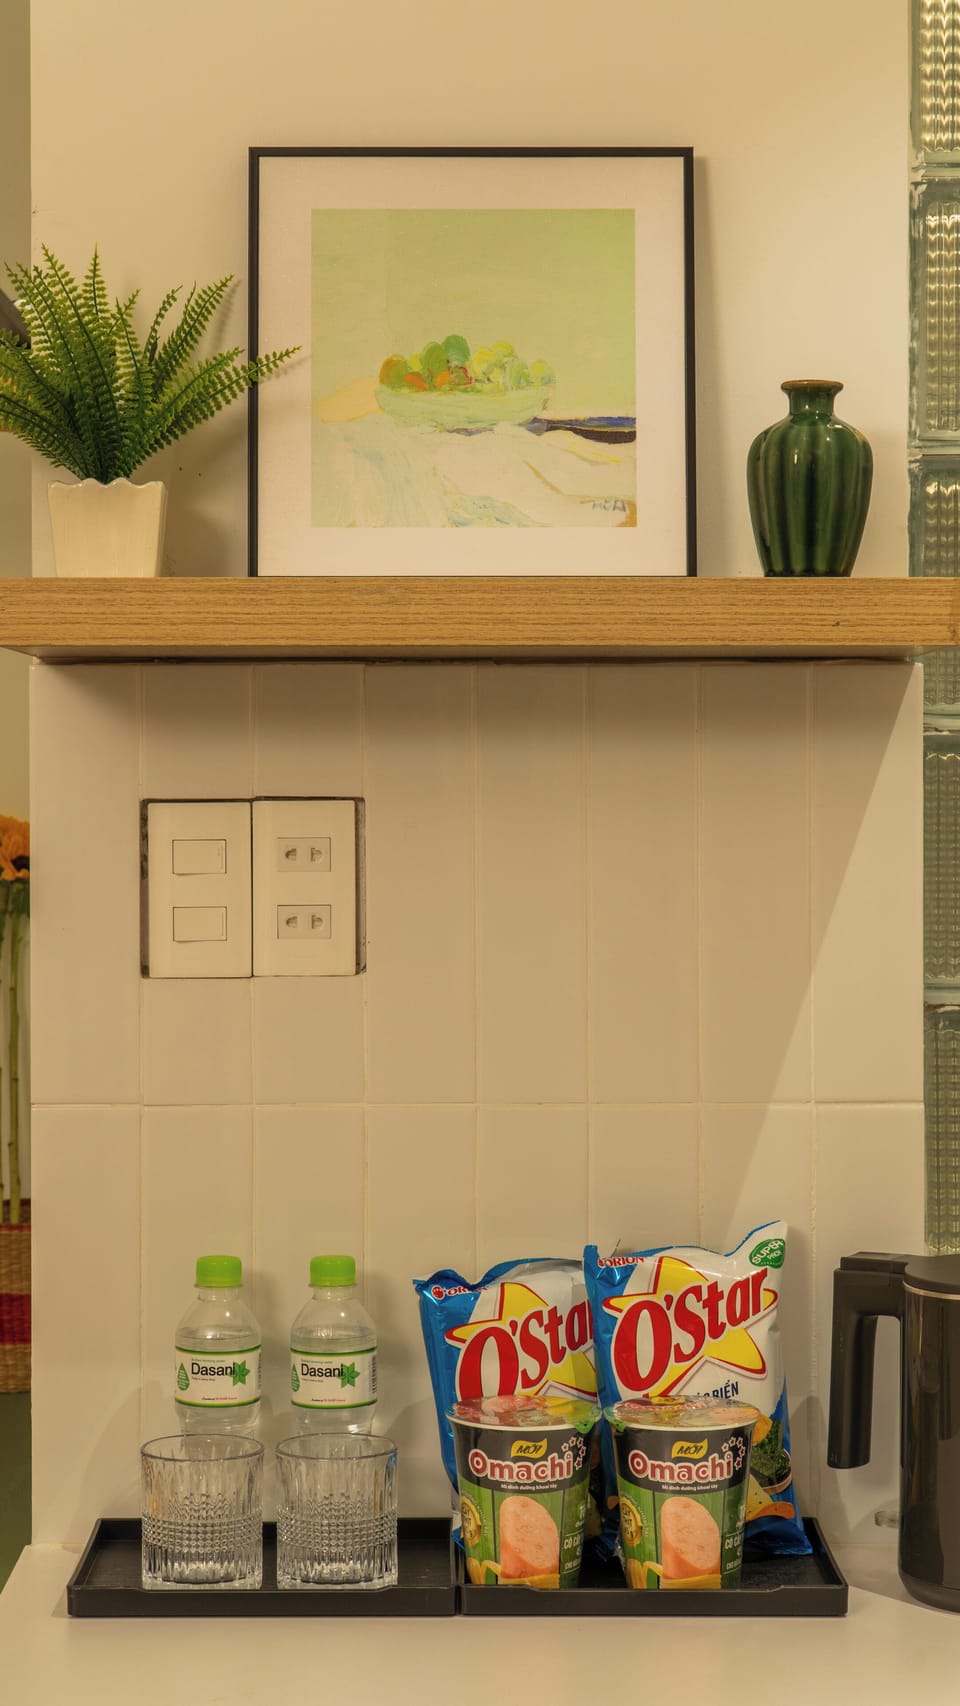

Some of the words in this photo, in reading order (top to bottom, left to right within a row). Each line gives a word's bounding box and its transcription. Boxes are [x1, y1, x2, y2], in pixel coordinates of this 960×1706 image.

[752, 1240, 784, 1264] SUPER
[613, 1268, 768, 1392] O'Star
[191, 1362, 236, 1377] Dasani
[301, 1363, 344, 1378] Dasani
[468, 1449, 574, 1484] Omachi
[628, 1449, 734, 1484] Omachi
